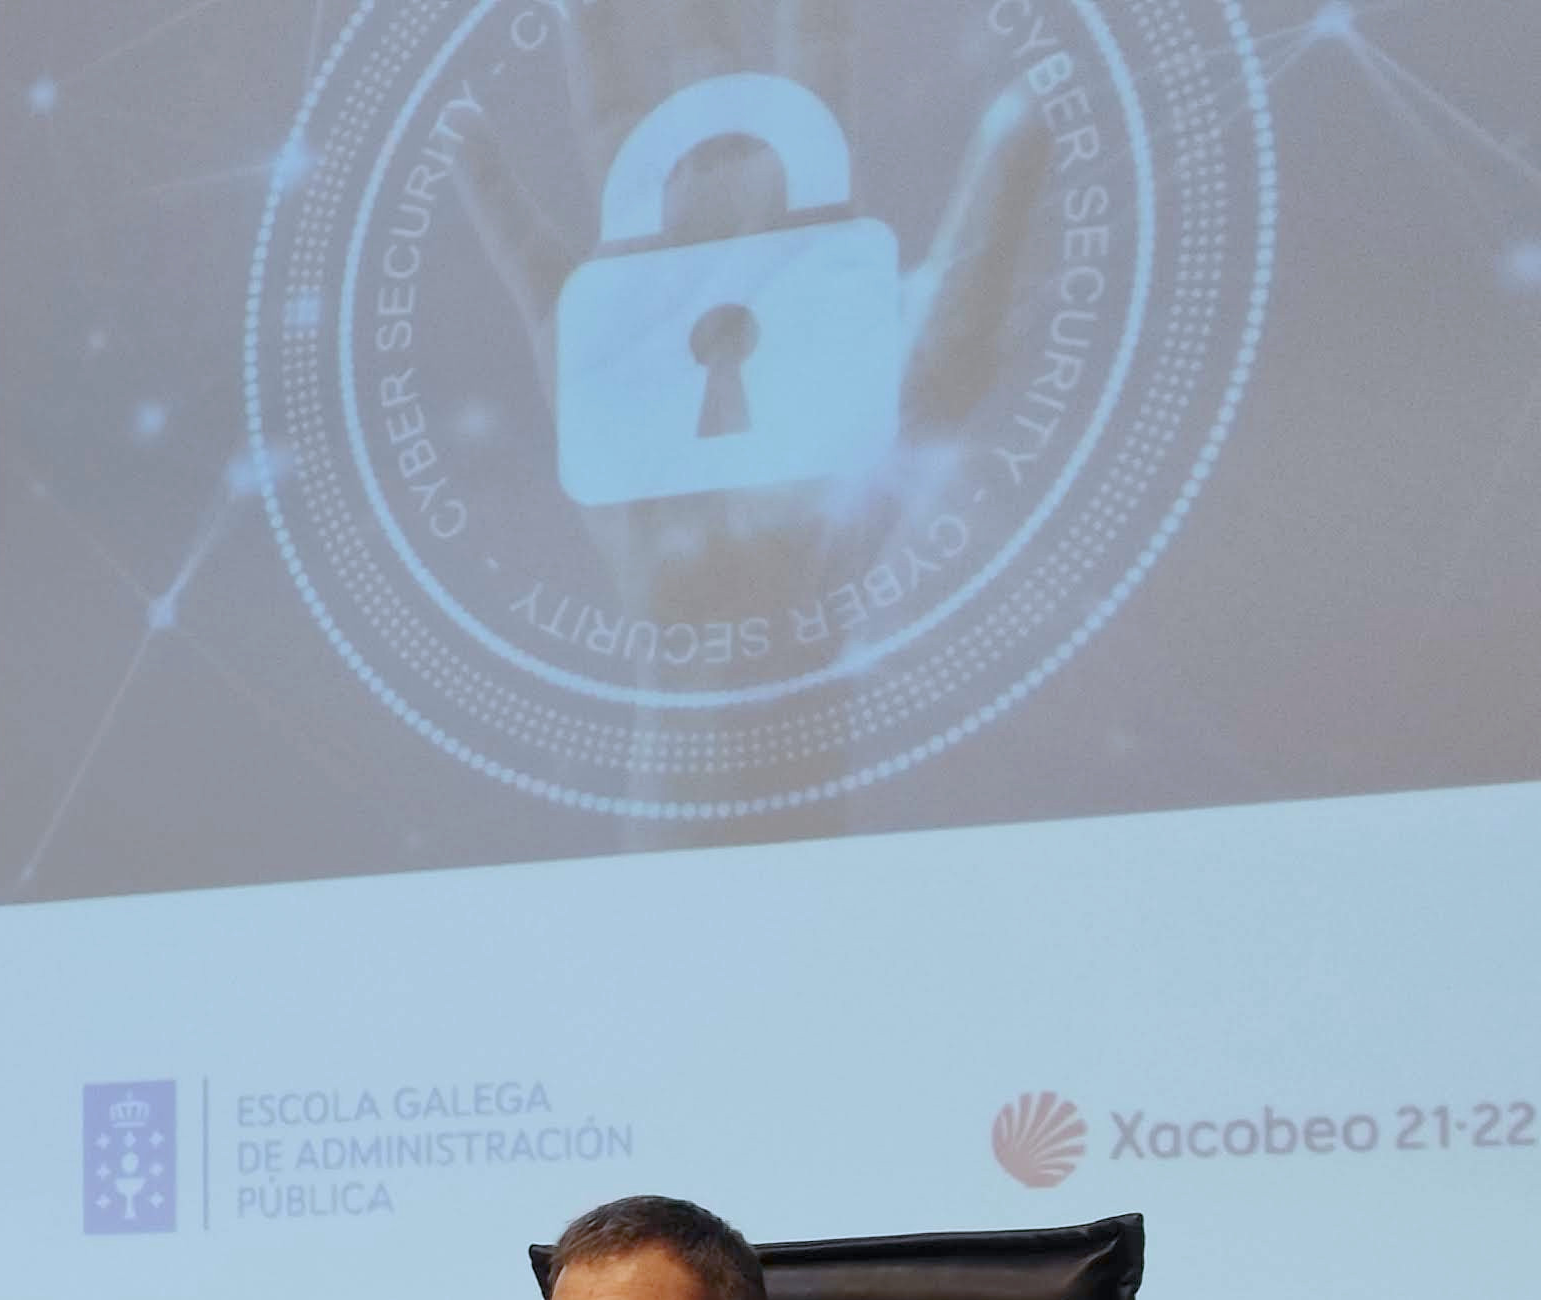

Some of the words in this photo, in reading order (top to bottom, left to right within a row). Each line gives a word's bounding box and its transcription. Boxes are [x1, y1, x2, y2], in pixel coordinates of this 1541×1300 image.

[988, 0, 1100, 172] CYBER
[375, 79, 484, 351] SECURITY
[992, 185, 1110, 485] SECURITY
[380, 367, 467, 537] CYBER
[509, 582, 771, 664] SECURITY
[793, 514, 967, 644] CYBER
[237, 1090, 380, 1127] ESCOLA
[395, 1082, 552, 1120] GALEGA
[237, 1140, 284, 1173] DE
[296, 1116, 633, 1170] ADMINISTRACIÓN
[1110, 1106, 1379, 1160] Xacobeo
[237, 1177, 395, 1219] PÚBLICA
